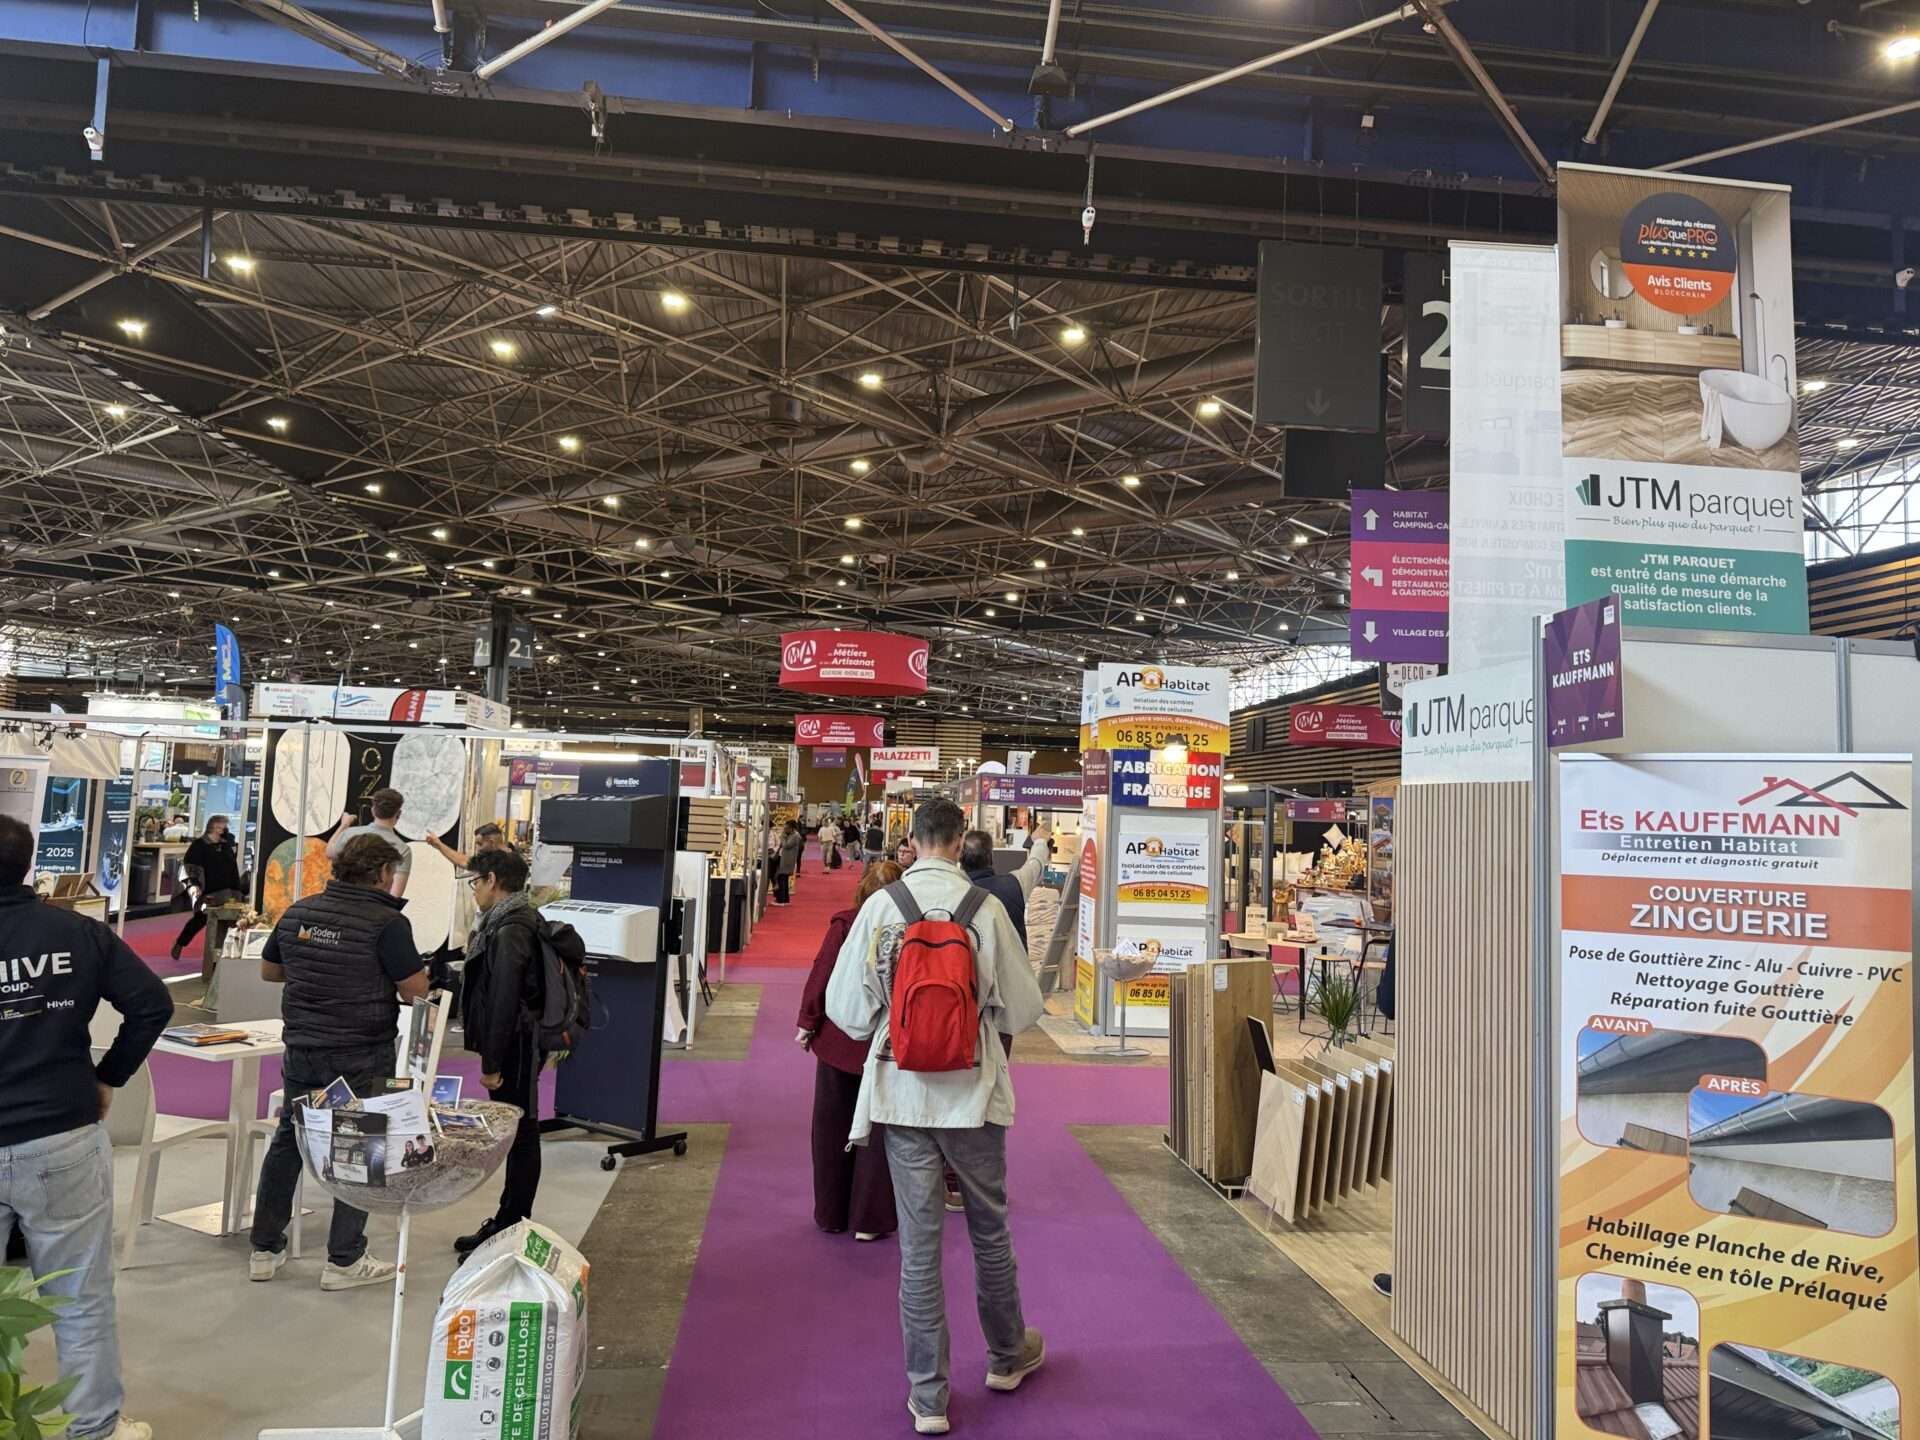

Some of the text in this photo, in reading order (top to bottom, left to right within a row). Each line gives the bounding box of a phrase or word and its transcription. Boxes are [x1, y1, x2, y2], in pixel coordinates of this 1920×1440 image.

[1648, 274, 1712, 291] Avis Clients
[1420, 300, 1450, 370] 2
[1608, 476, 1794, 521] JTM parquet
[1613, 516, 1755, 535] Bien plus que du parquet
[1640, 554, 1736, 569] JTM PARQUET
[1591, 567, 1787, 588] est entré dans une démarche
[1611, 582, 1768, 602] qualité de mesure de la
[1624, 599, 1756, 616] satisfaction clients.
[1392, 629, 1445, 637] VILLAGE DES
[832, 658, 875, 667] Artisanat
[833, 649, 868, 658] Métiers
[1573, 648, 1591, 665] ETS
[1116, 672, 1210, 691] AP Habitat
[1552, 661, 1615, 688] KAUFFMANN
[1421, 694, 1465, 736] JTM
[1116, 730, 1209, 746] 06 85 25
[873, 751, 931, 760] PALAZZETTI
[1114, 761, 1220, 777] FABRICATION
[1580, 809, 1841, 837] Ets KAUFFMANN
[46, 848, 74, 857] 2025
[1126, 842, 1199, 857] AP Habitat
[1620, 835, 1798, 854] Entretien Habitat
[1601, 851, 1819, 871] Déplacement et diagnostic gratuit
[1649, 885, 1807, 908] COUVERTURE
[1630, 904, 1829, 939] ZINGUERIE
[1569, 945, 1903, 983] Pose de Gouttière Zinc Alu Cuivre PVC
[1130, 989, 1165, 998] 06 85 04
[1635, 972, 1825, 1000] Nettoyage Gouttière
[1610, 992, 1854, 1026] Réparation fuite Gouttière
[1592, 1018, 1649, 1033] AVANT
[1707, 1077, 1761, 1095] APRÈS
[1586, 1215, 1885, 1283] Habillage Planche de Rive,
[1585, 1242, 1888, 1310] Cheminée en tôle Prélaqué
[453, 1315, 475, 1355] igloo
[514, 1310, 530, 1421] DE CELLULOSE
